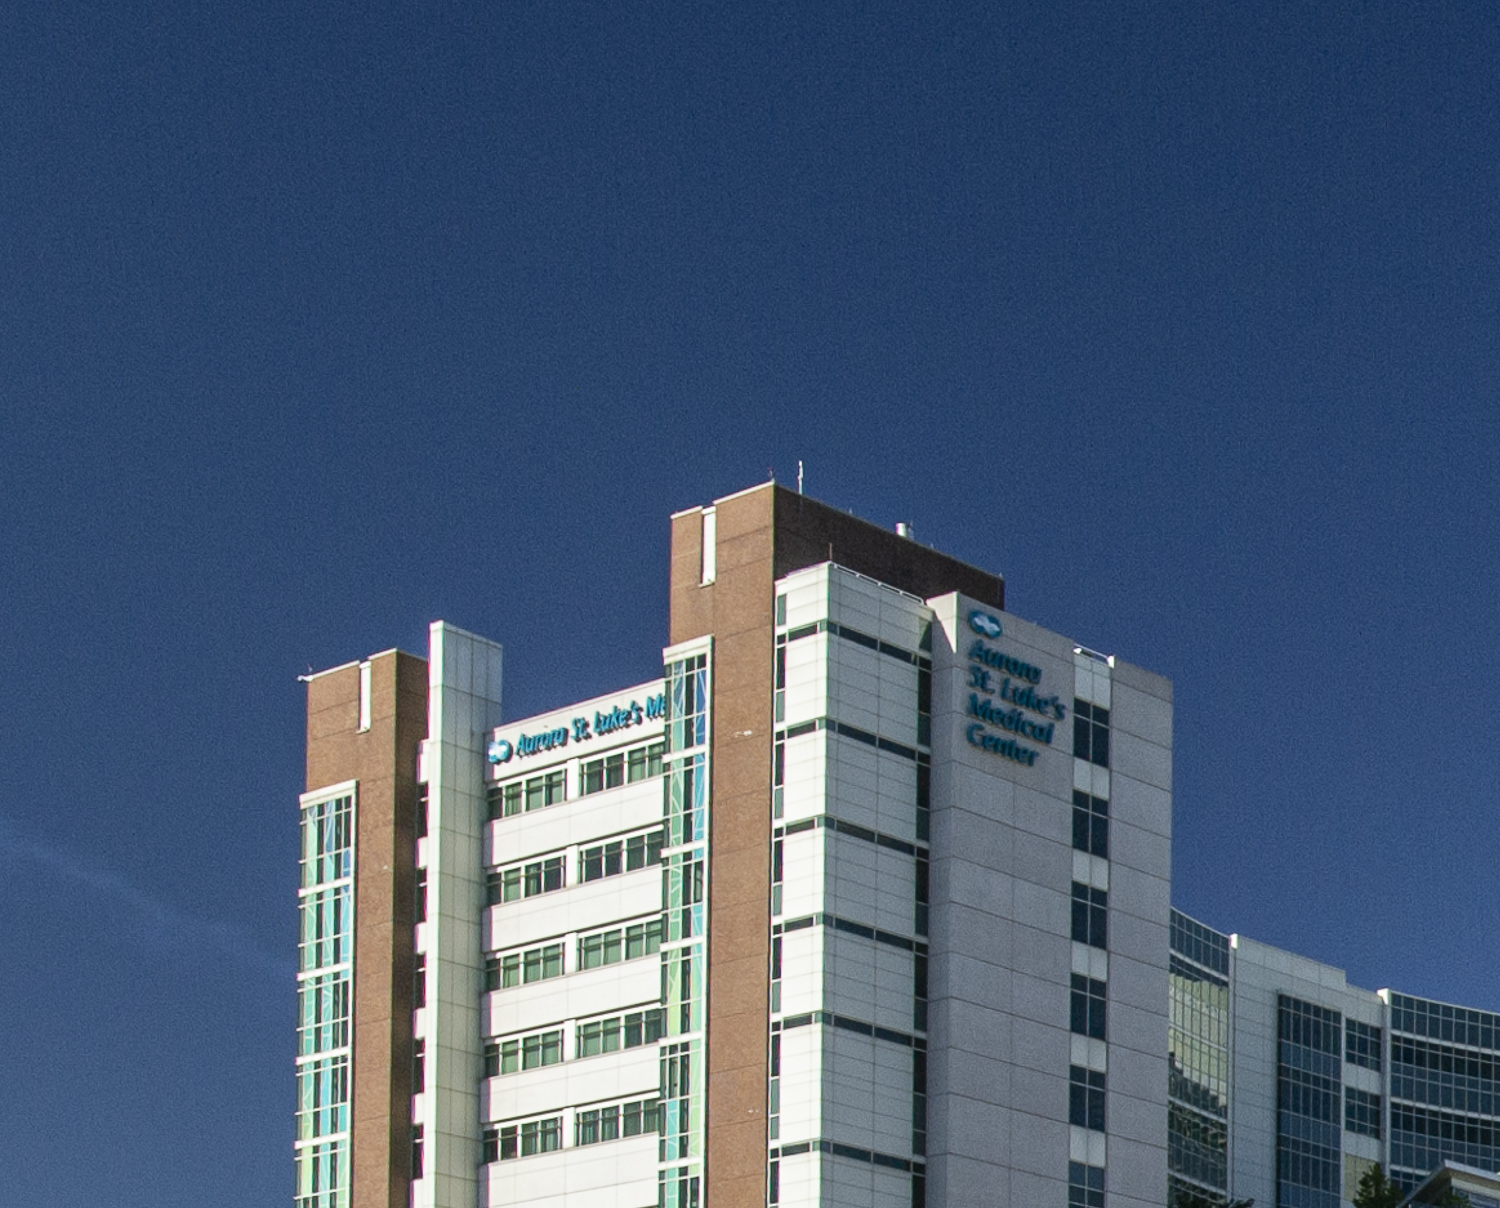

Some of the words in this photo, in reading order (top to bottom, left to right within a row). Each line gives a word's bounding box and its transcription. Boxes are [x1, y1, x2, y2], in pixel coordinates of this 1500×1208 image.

[968, 640, 1042, 685] Aurora
[968, 665, 995, 694] St.
[1002, 678, 1066, 721] Luke's
[968, 692, 1055, 744] Medical
[515, 726, 569, 758] Aurora
[571, 717, 592, 742] St.
[593, 701, 643, 736] Luke's
[966, 723, 1039, 767] Center
